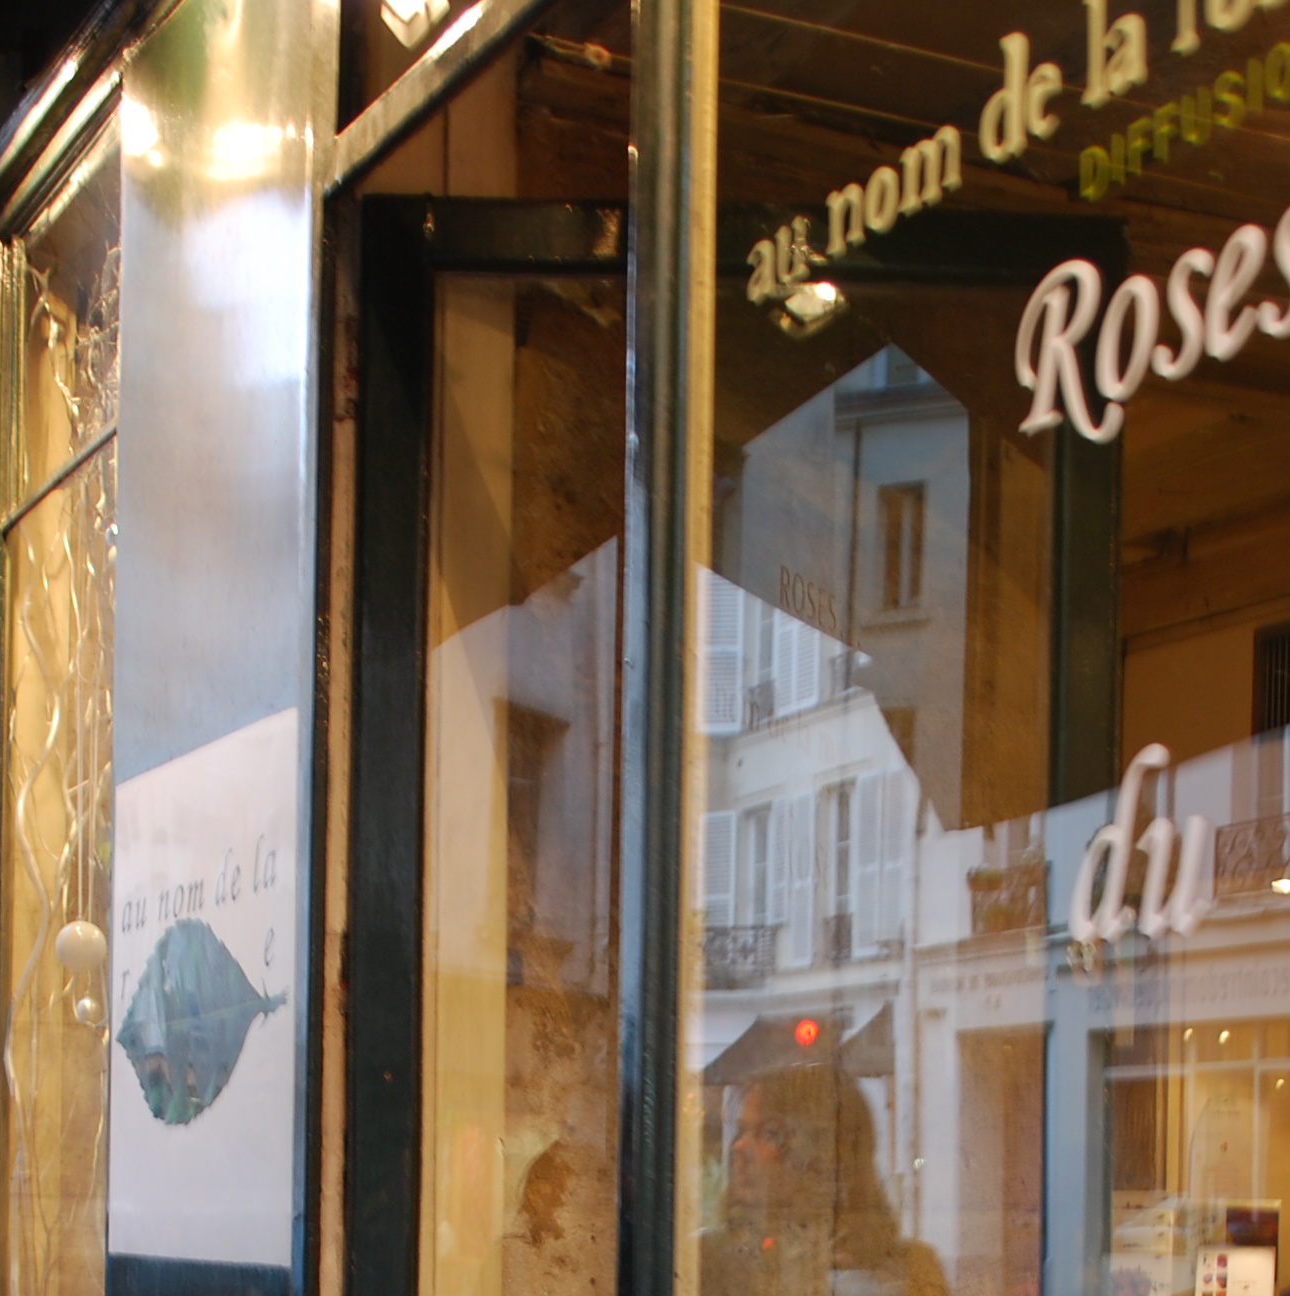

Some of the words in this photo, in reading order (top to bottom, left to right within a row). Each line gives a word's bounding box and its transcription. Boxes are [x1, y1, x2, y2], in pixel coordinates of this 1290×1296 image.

[825, 124, 964, 261] nom
[979, 31, 1062, 163] de
[121, 898, 146, 933] au
[159, 880, 205, 921] nom
[214, 847, 242, 907] de
[252, 834, 278, 897] la
[1066, 743, 1219, 942] du
